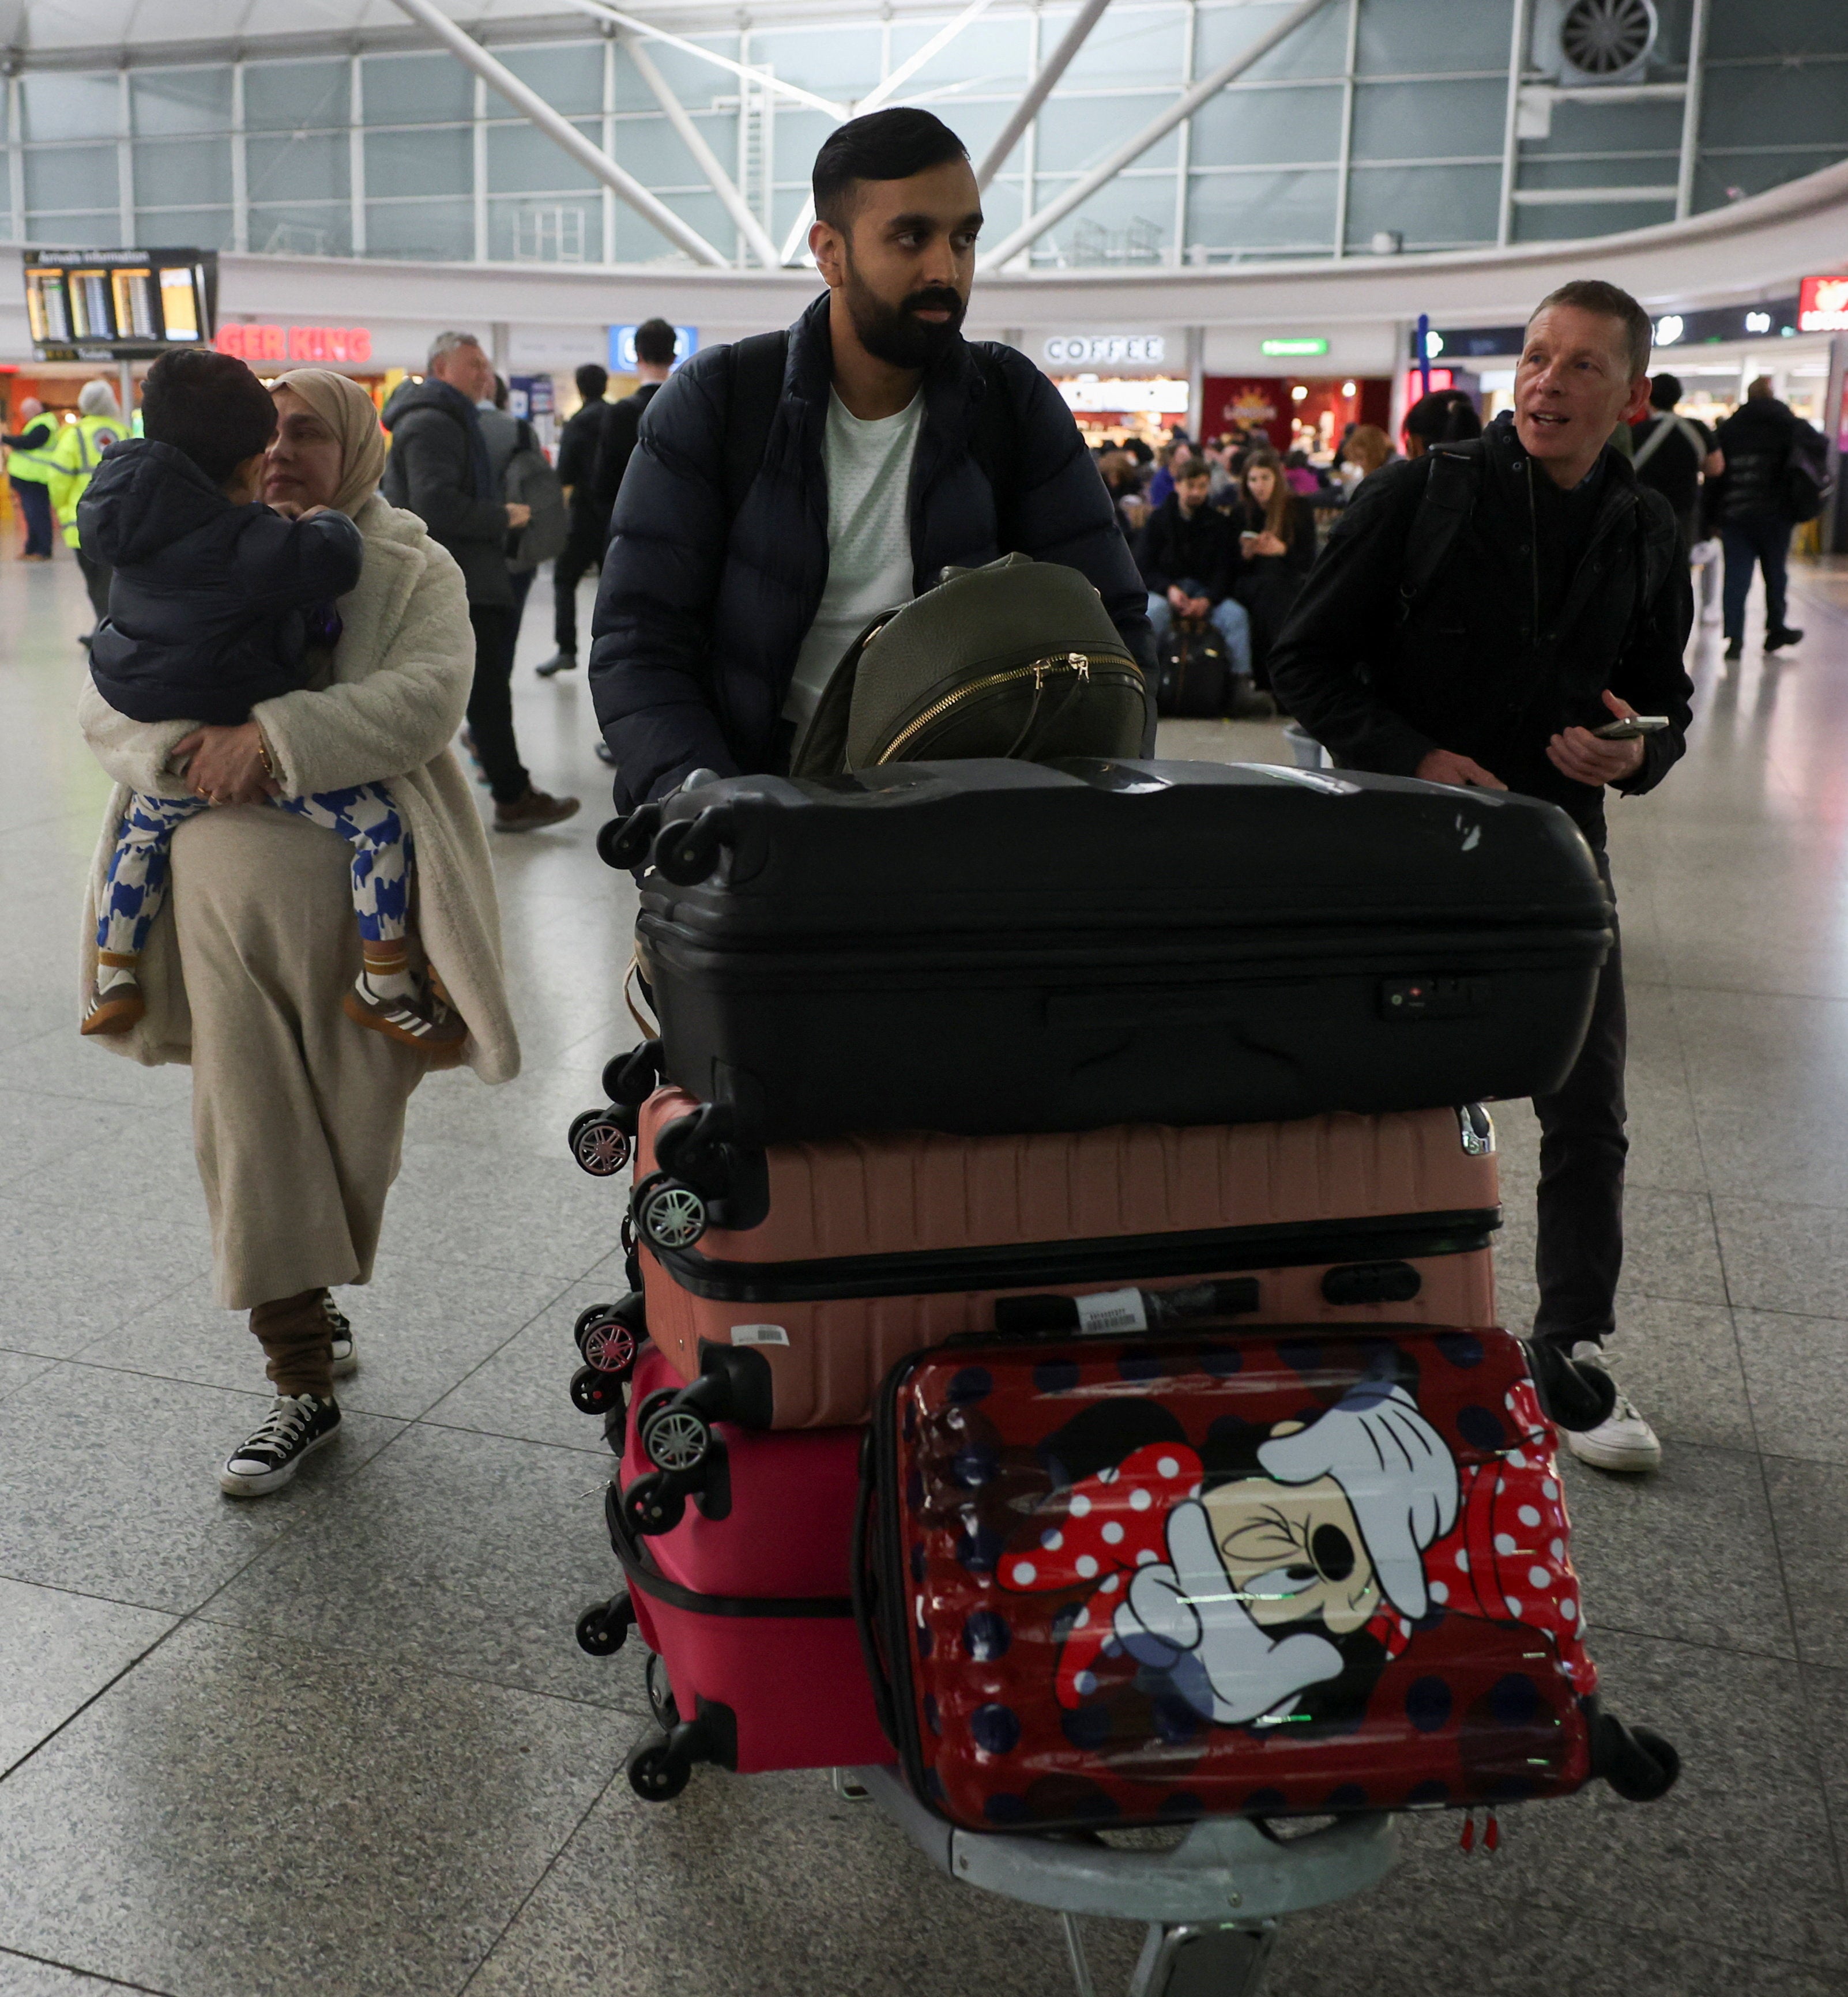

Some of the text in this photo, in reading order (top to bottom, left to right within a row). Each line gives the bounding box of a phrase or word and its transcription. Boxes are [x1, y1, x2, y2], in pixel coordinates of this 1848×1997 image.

[210, 323, 371, 363] GER KING
[1046, 337, 1161, 363] COFFEE
